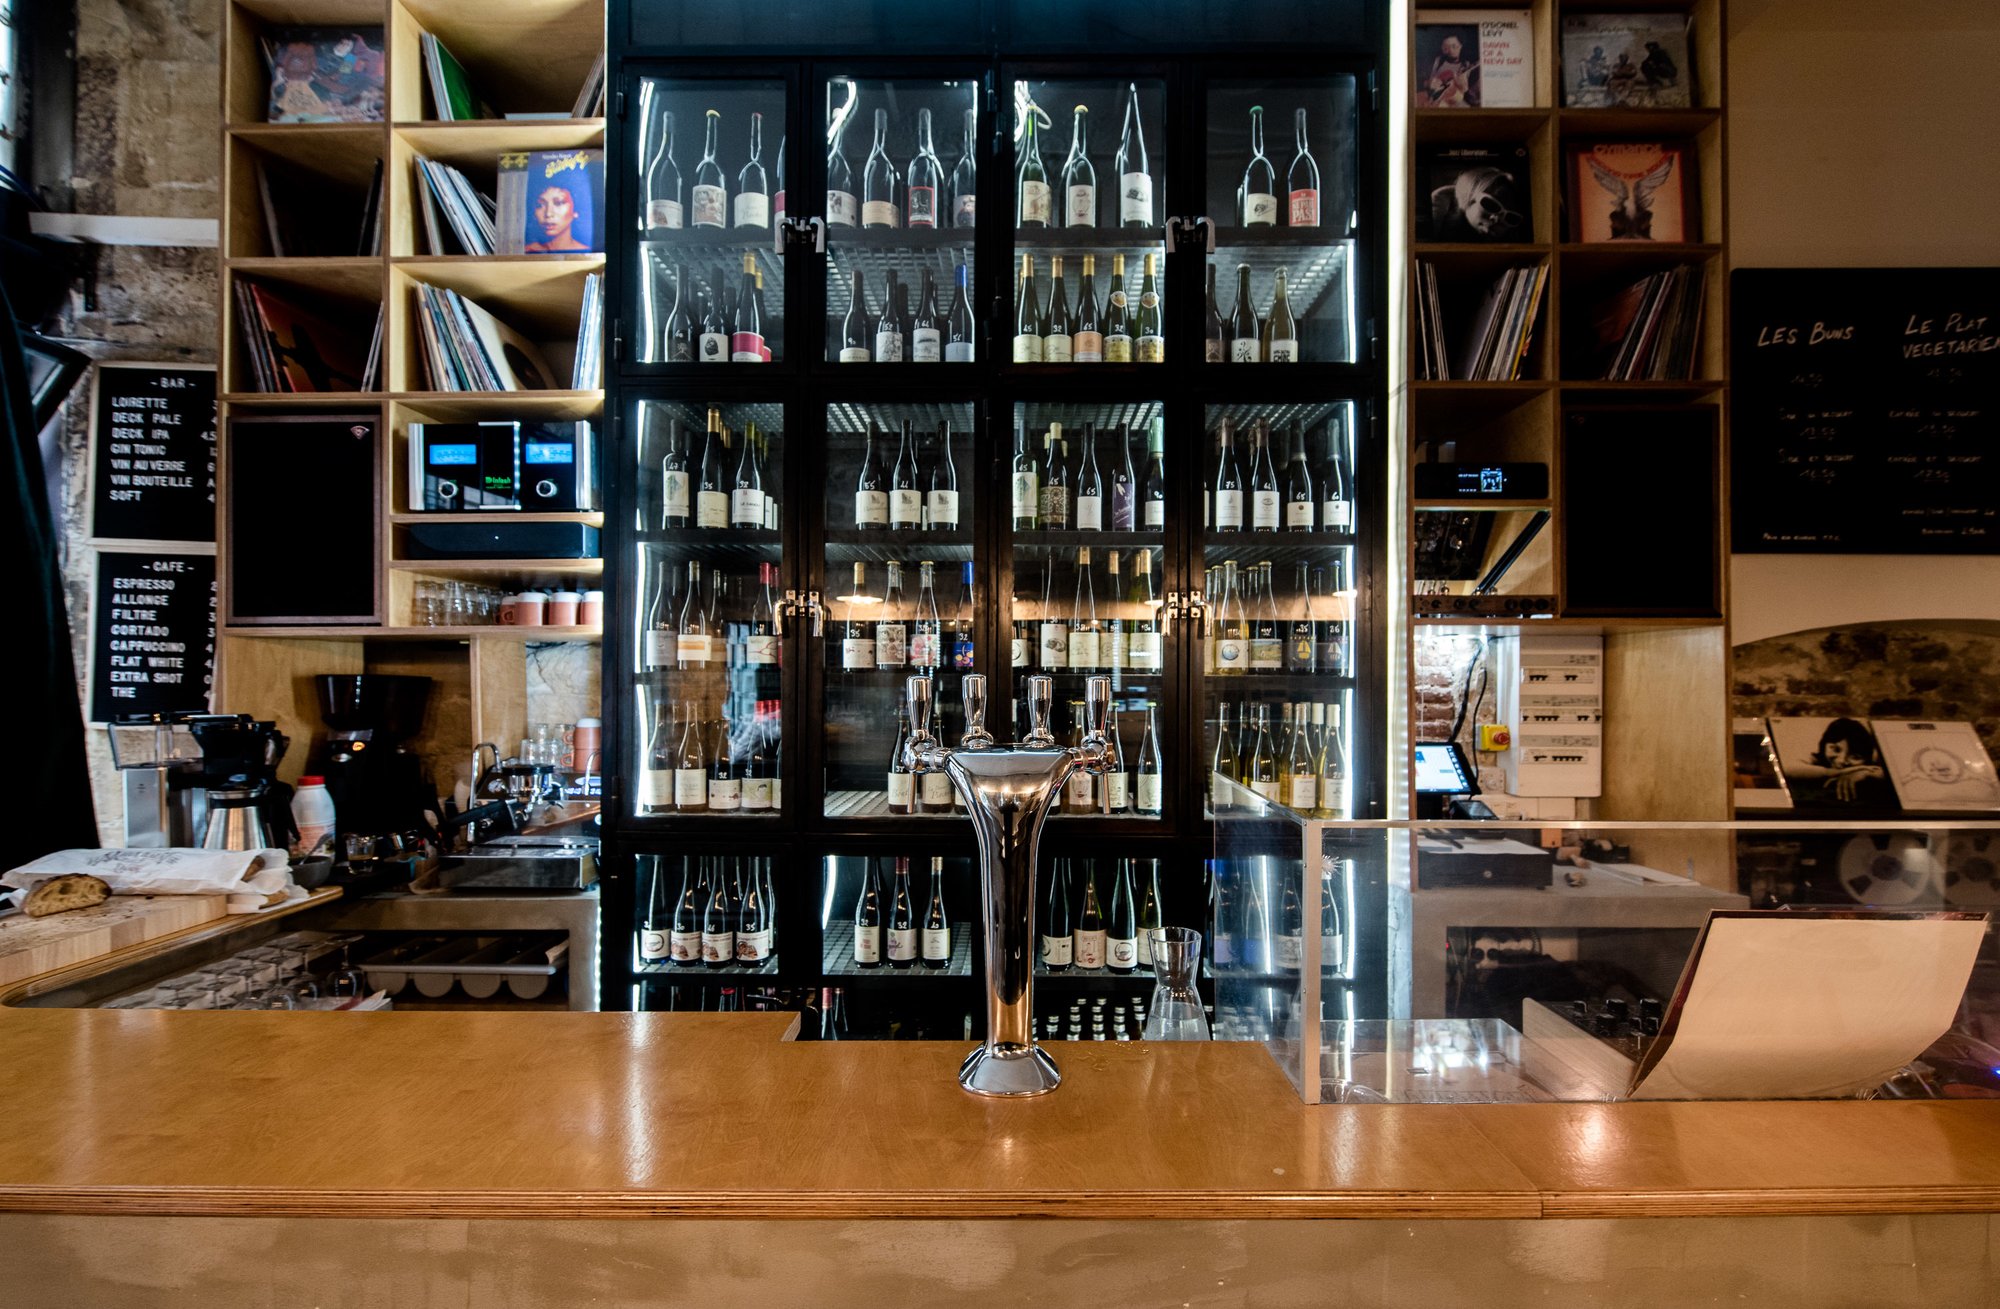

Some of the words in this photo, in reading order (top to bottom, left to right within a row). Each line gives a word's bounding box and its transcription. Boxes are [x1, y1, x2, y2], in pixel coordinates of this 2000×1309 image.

[160, 377, 186, 389] BAR
[111, 396, 169, 409] LOIRETTE
[112, 411, 144, 424] DECK
[152, 413, 182, 425] PALE
[111, 427, 144, 439] DECK
[151, 428, 170, 440] IPA
[110, 443, 131, 455] GIN
[132, 443, 167, 456] TONIC
[110, 459, 131, 470] VIN
[110, 474, 131, 486] VIN
[132, 474, 194, 488] BOUTEILLE
[109, 489, 143, 502] SOFT
[152, 561, 185, 573] CAFE
[112, 577, 175, 590] ESPRESSO
[111, 608, 157, 621] FILTRE
[208, 612, 216, 623] 3
[110, 624, 169, 637] CORTADO
[207, 627, 215, 638] 3
[110, 640, 186, 653] CAPPUCCINO
[110, 655, 143, 667] FLAT
[147, 656, 184, 668] WHITE
[110, 671, 149, 683] EXTRA
[152, 672, 184, 684] SHOT
[110, 686, 136, 698] THE
